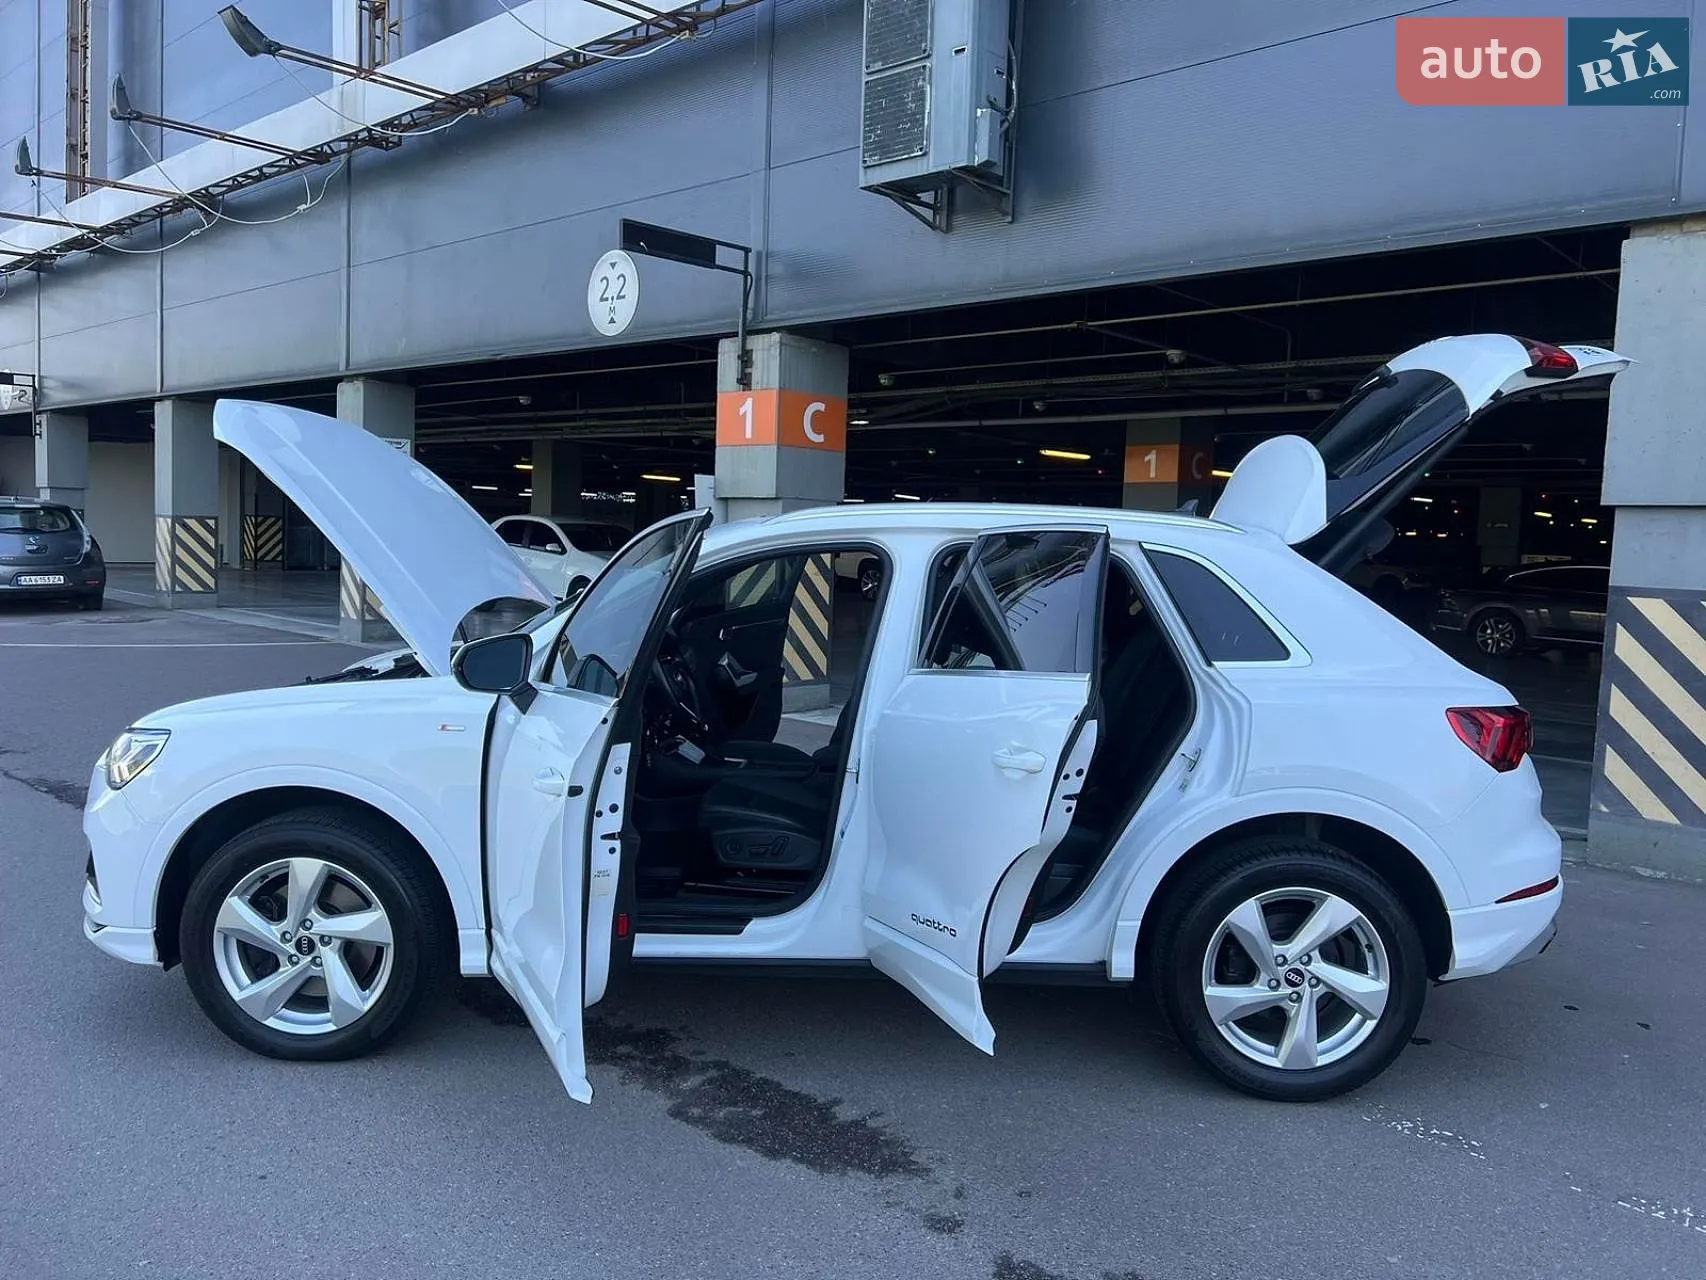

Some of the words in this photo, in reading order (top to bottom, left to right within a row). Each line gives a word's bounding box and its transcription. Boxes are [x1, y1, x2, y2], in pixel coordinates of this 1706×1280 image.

[738, 396, 754, 440] 1
[802, 401, 826, 443] C
[1143, 449, 1158, 479] 1
[911, 912, 957, 938] quattro
